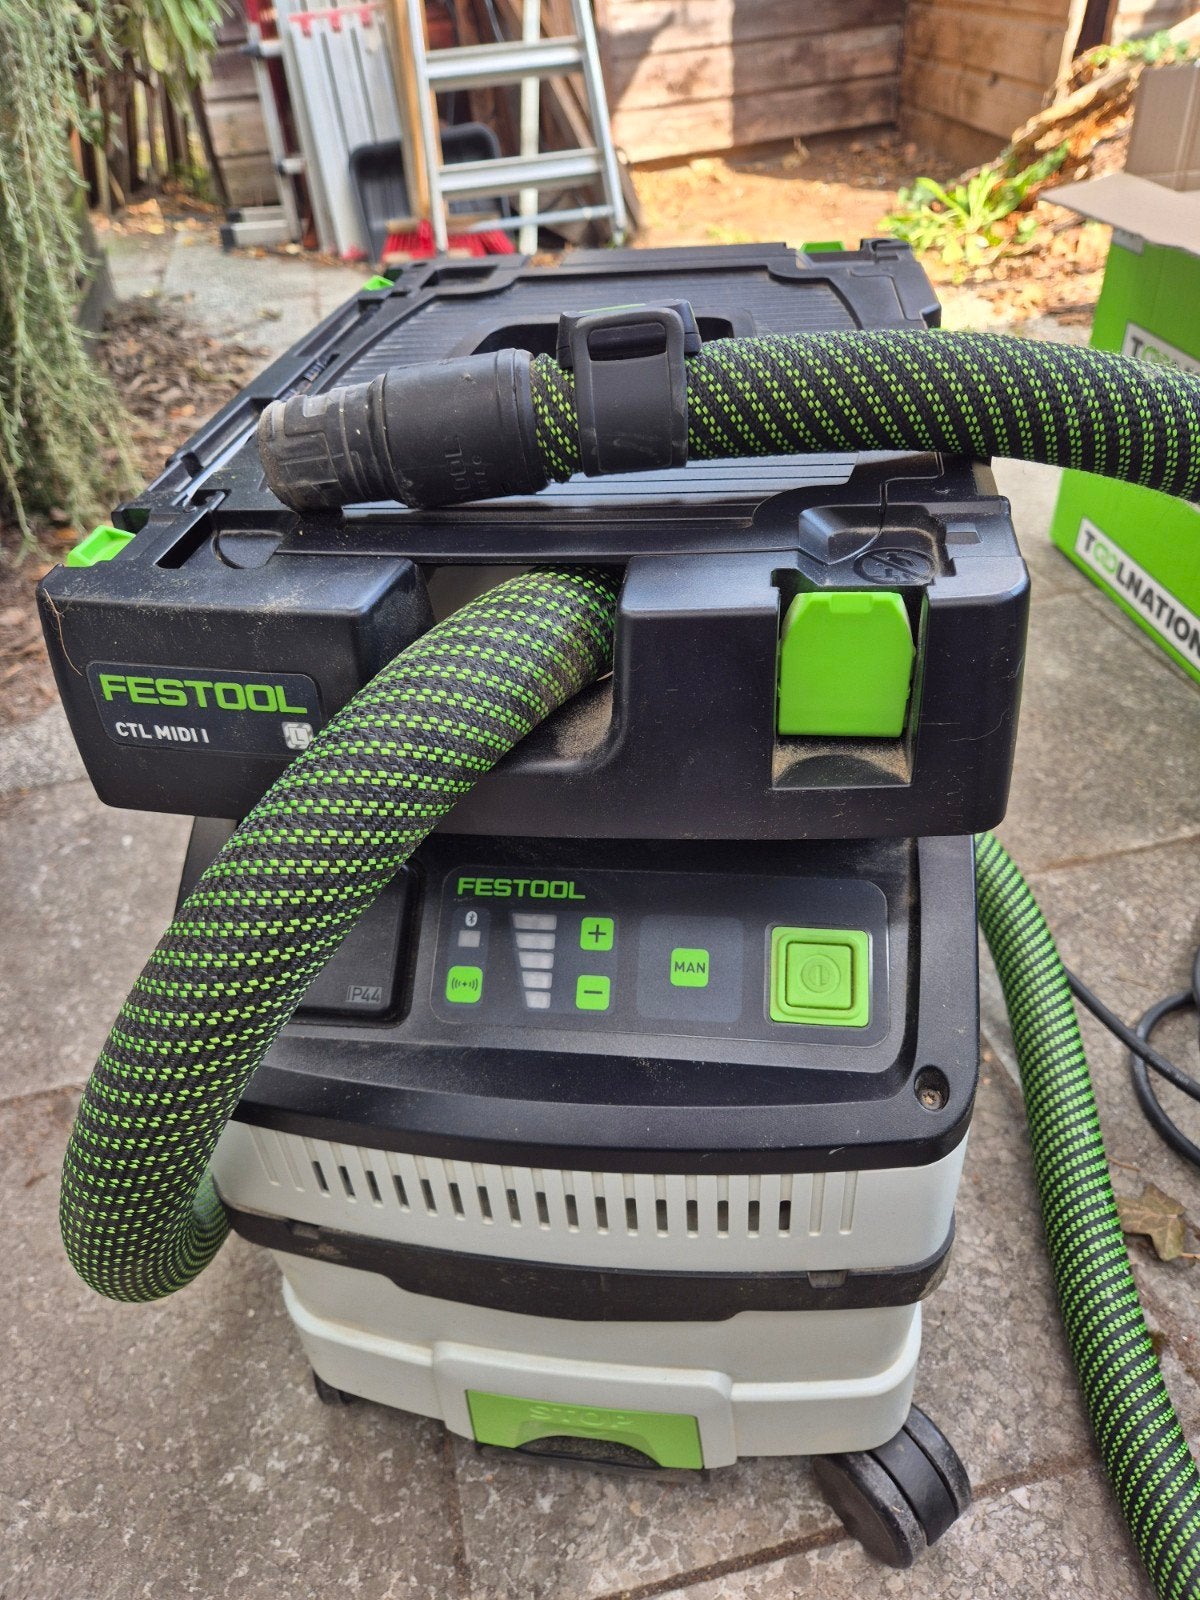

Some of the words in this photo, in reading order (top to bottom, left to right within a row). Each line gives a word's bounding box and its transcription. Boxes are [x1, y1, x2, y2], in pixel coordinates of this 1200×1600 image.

[99, 674, 307, 714] FESTOOL
[115, 721, 152, 739] CTL
[153, 725, 198, 743] MIDI
[457, 877, 586, 900] FESTOOL
[674, 961, 706, 974] MAN
[529, 1406, 633, 1428] STOP
